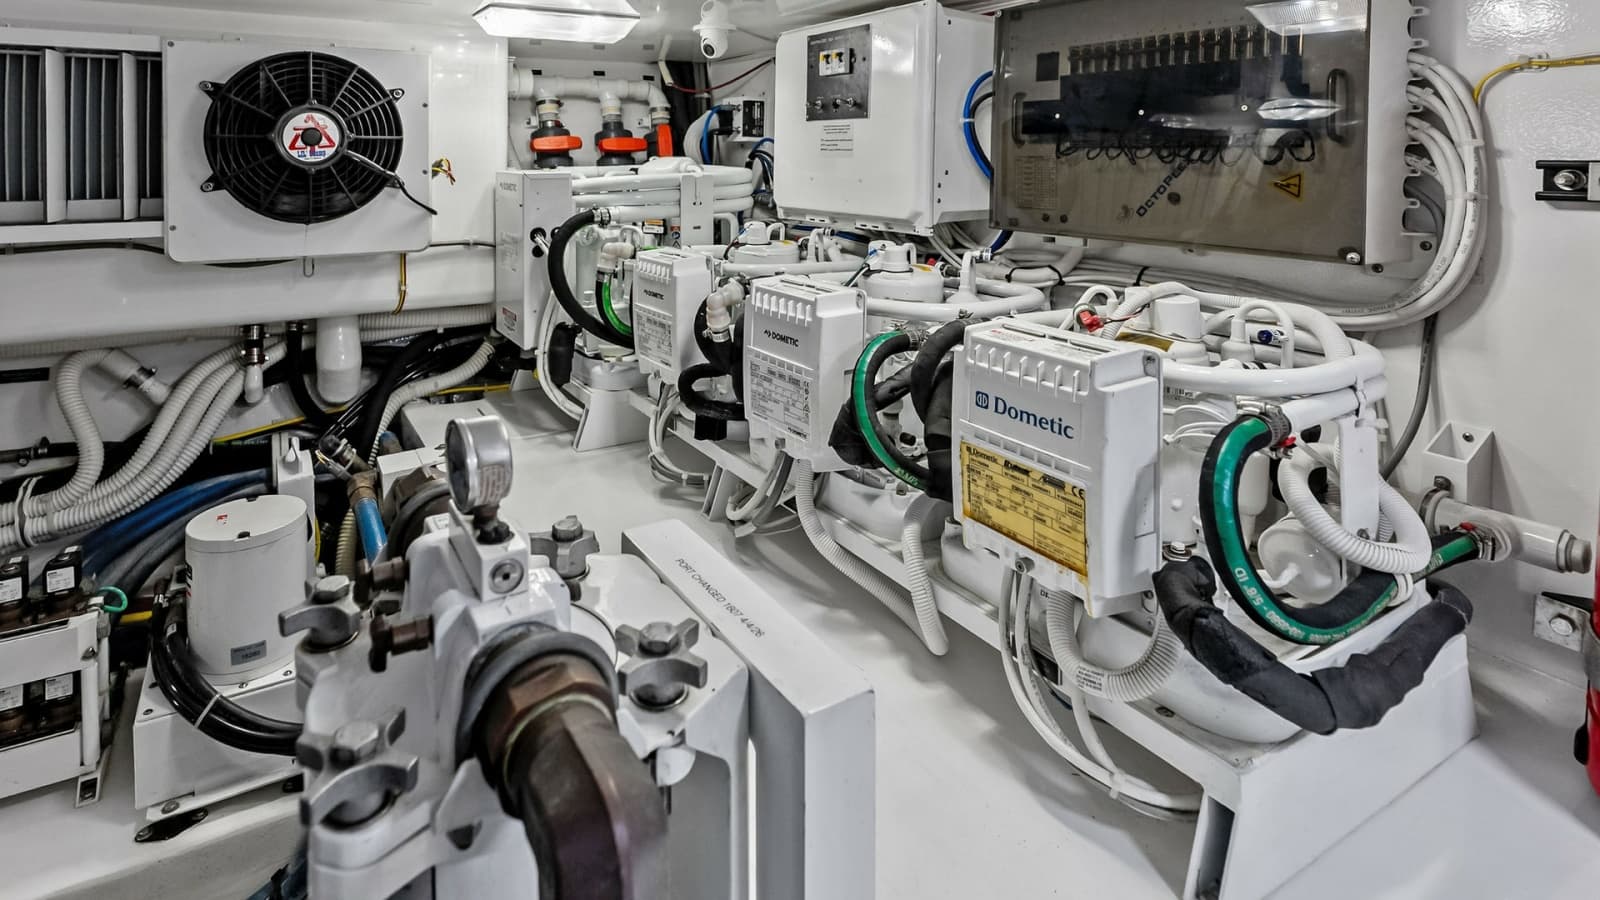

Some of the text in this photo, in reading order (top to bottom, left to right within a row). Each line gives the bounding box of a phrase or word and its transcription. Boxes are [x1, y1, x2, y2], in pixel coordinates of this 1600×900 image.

[1136, 156, 1192, 217] OCTOPLE
[771, 331, 799, 347] DOMETIC
[993, 395, 1074, 439] Dometic
[675, 558, 697, 574] PORT
[691, 573, 727, 603] CHANGED
[1234, 567, 1250, 583] ID
